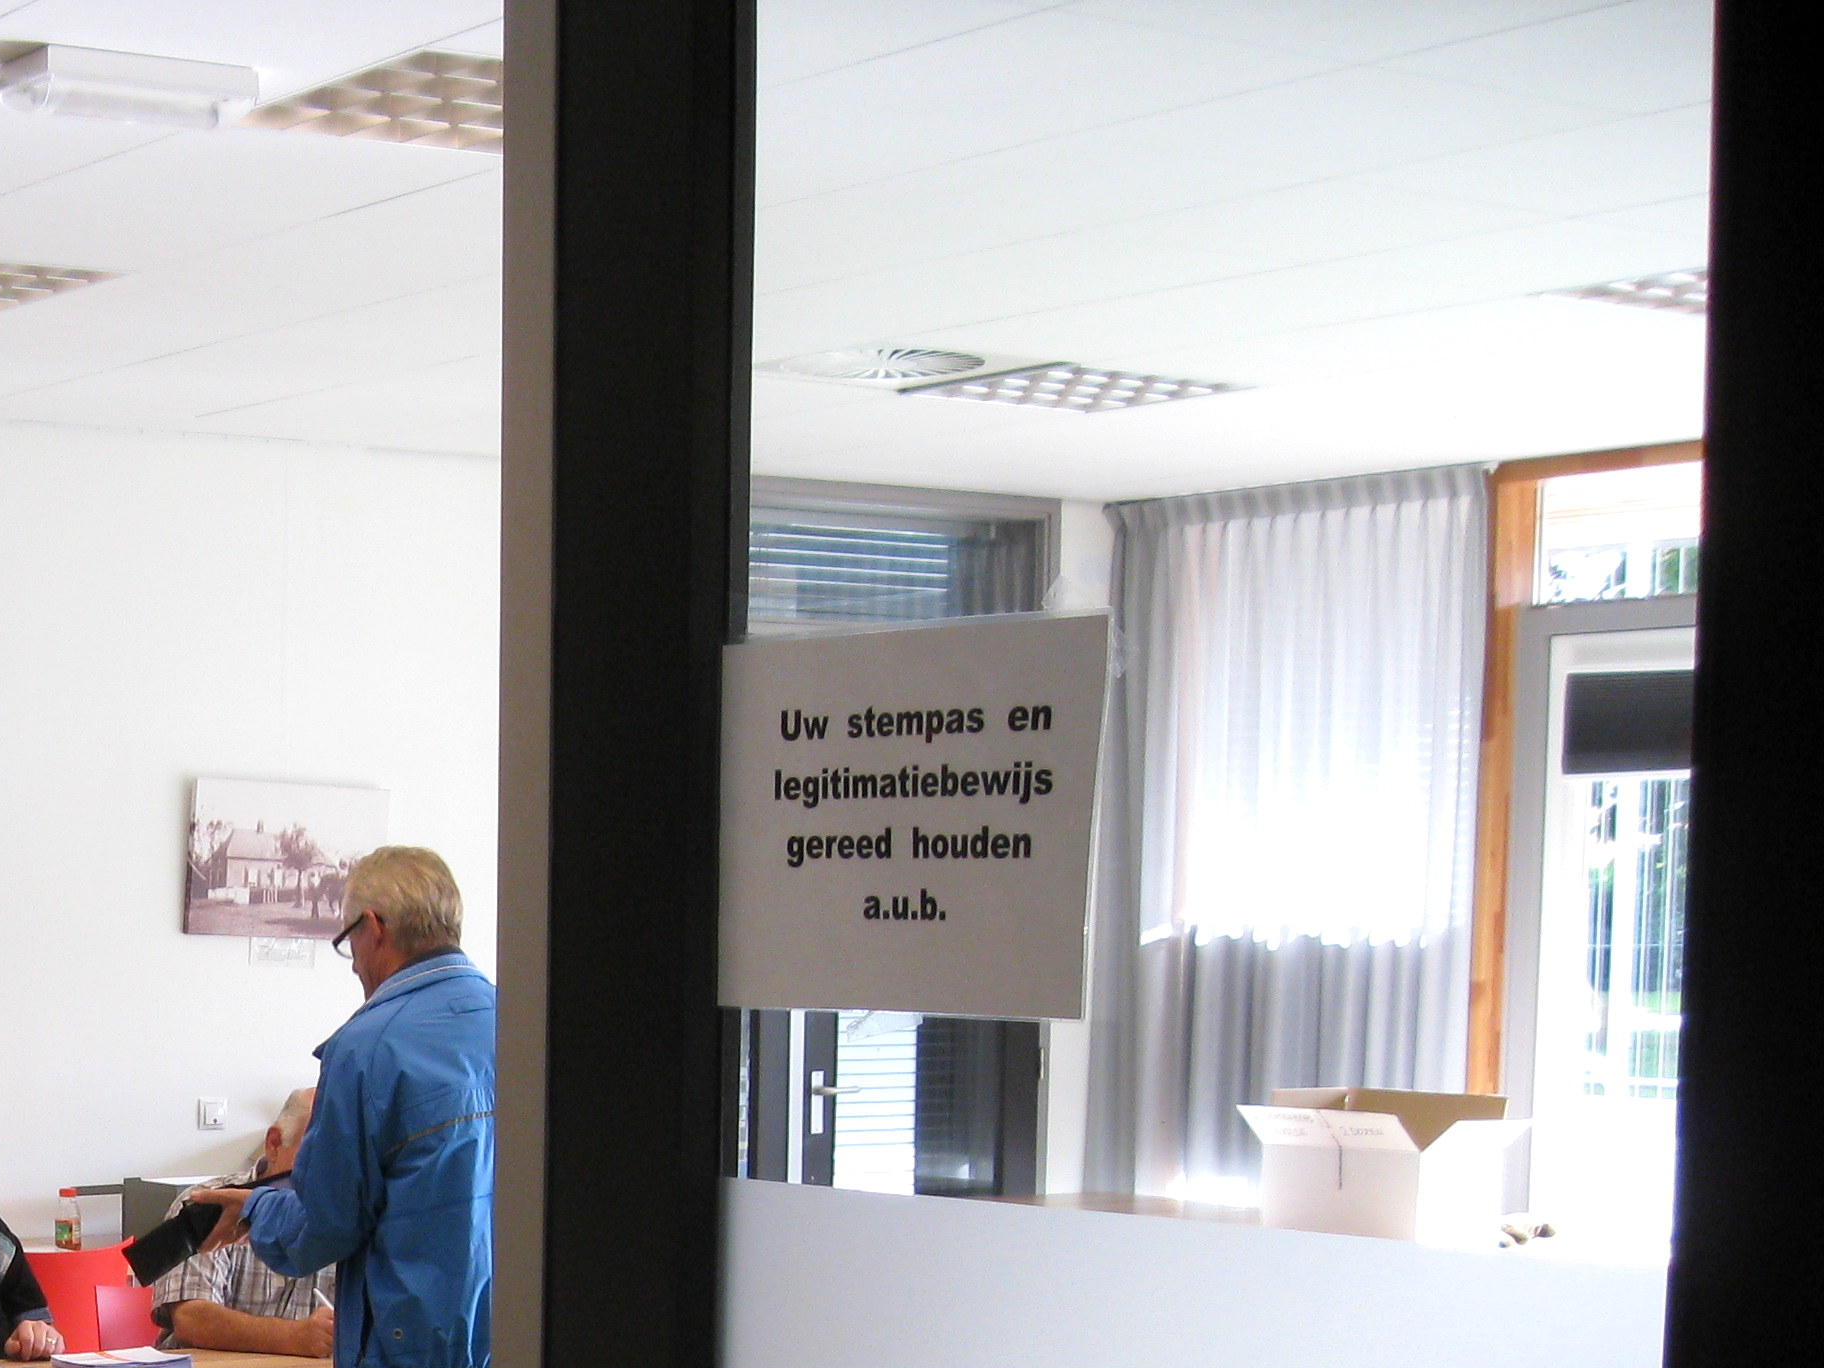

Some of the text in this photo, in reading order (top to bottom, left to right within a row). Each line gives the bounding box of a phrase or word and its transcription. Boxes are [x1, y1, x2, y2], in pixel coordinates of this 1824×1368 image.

[780, 704, 1052, 744] Uw stempas en
[774, 760, 1054, 809] legitimatiebewijs
[786, 825, 1032, 868] gereed houden
[863, 888, 947, 922] a.u.b.
